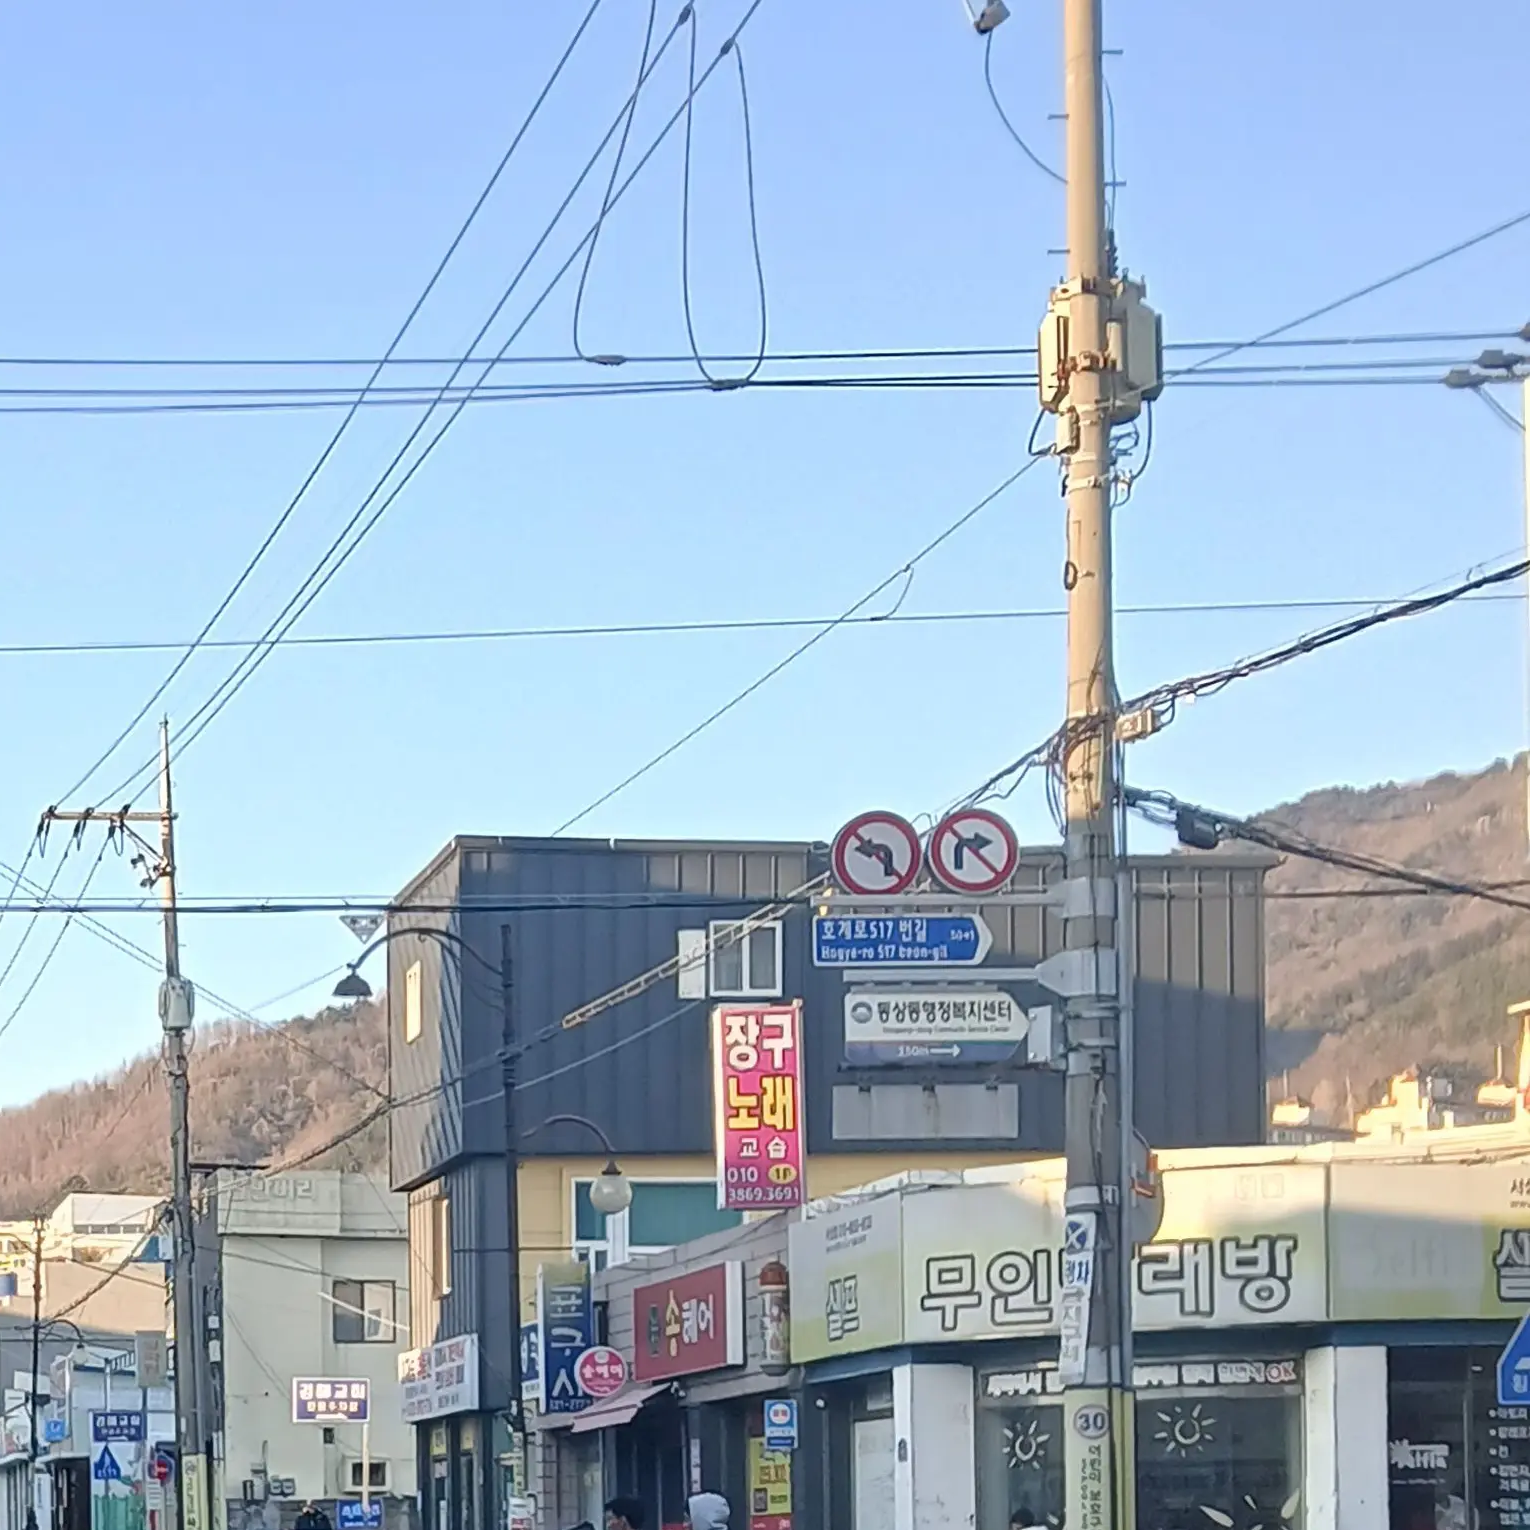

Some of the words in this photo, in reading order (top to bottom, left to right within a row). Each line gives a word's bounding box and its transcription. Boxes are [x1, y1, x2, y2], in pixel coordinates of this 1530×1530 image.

[899, 919, 927, 942] 번길
[725, 1013, 794, 1070] 장구
[727, 1076, 796, 1131] 노래
[739, 1136, 787, 1160] 교습
[727, 1167, 758, 1183] 010
[921, 1233, 1299, 1333] 무인래방
[1078, 1411, 1107, 1432] 30
